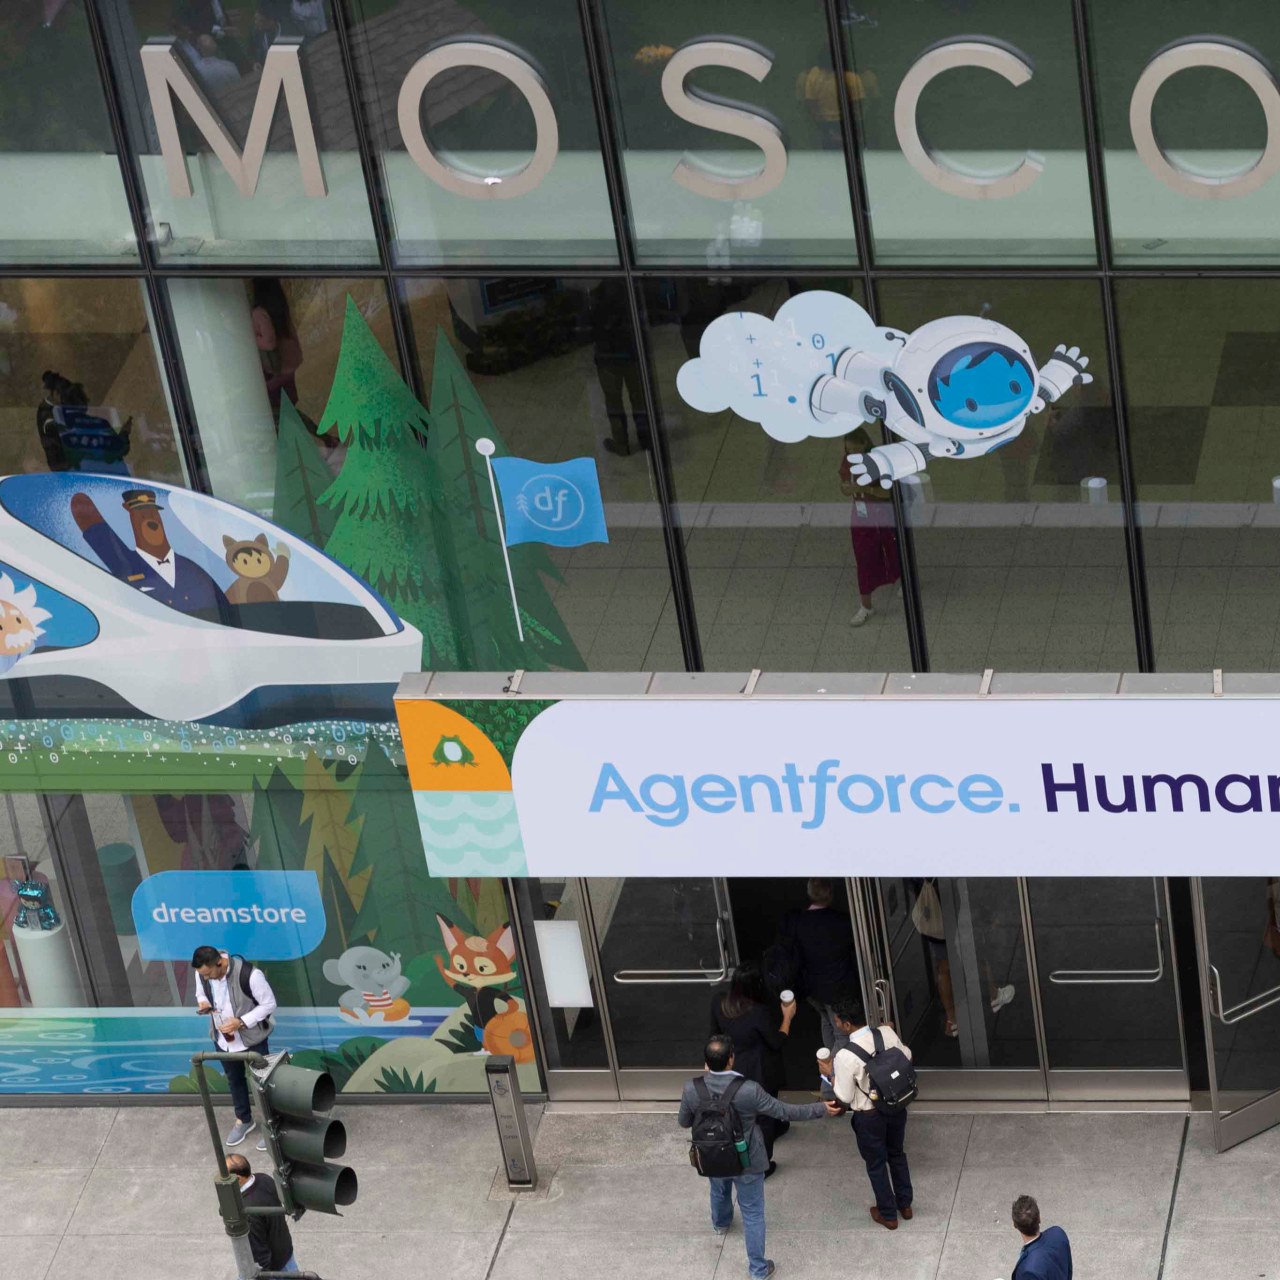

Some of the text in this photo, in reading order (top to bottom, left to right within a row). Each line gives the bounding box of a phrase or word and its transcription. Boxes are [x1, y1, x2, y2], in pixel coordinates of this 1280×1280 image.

[534, 485, 568, 522] df
[589, 759, 1021, 829] Agentforce.
[152, 902, 307, 924] dreamstore
